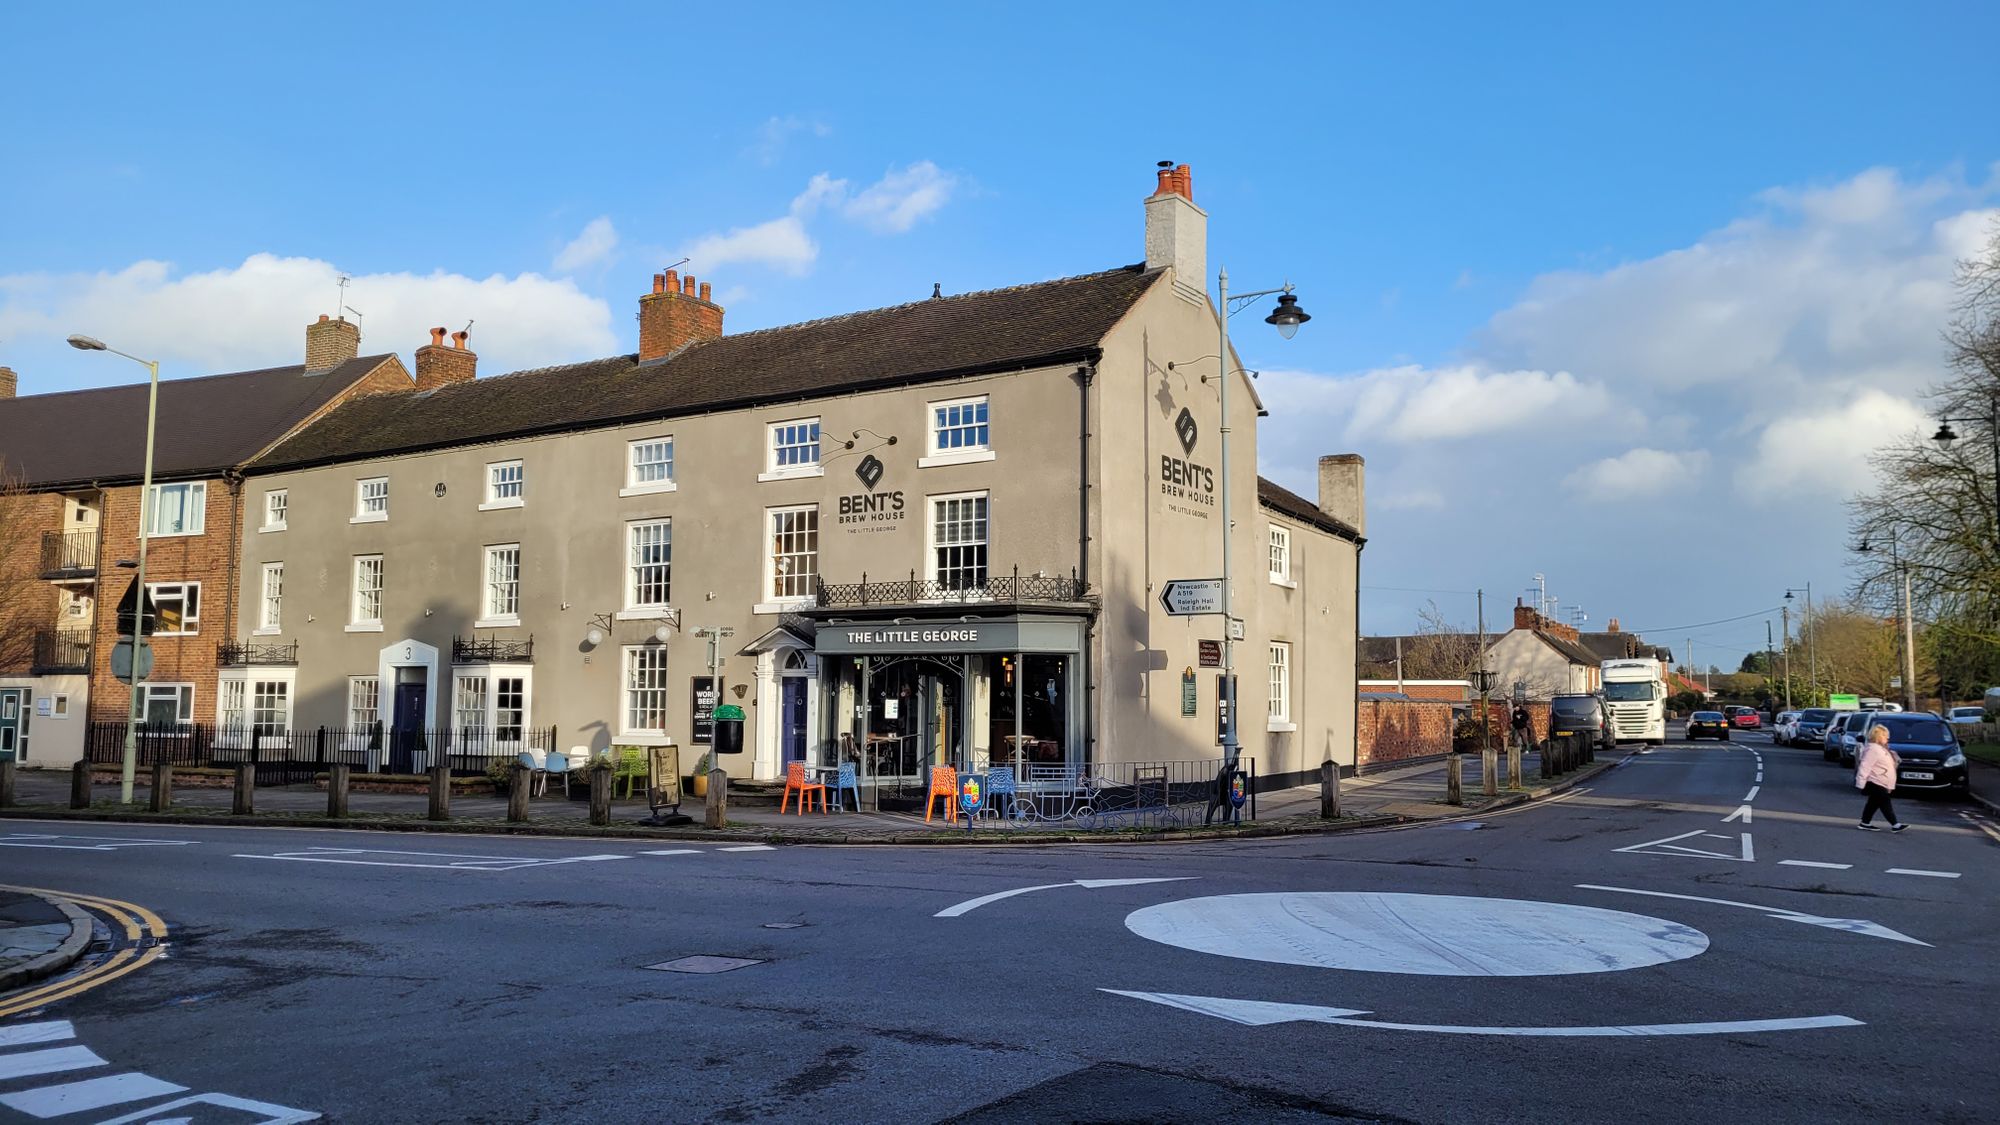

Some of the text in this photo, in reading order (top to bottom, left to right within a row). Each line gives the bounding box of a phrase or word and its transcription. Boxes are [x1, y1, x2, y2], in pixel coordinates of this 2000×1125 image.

[1161, 455, 1213, 493] BENT'S
[839, 491, 904, 515] BENT'S
[1161, 484, 1214, 506] BREW HOUSE
[839, 512, 904, 524] BREW HOUSE
[1168, 504, 1208, 520] THE LITTLE GEORGE
[847, 630, 978, 643] THE LITTLE GEORGE
[405, 646, 411, 660] 3
